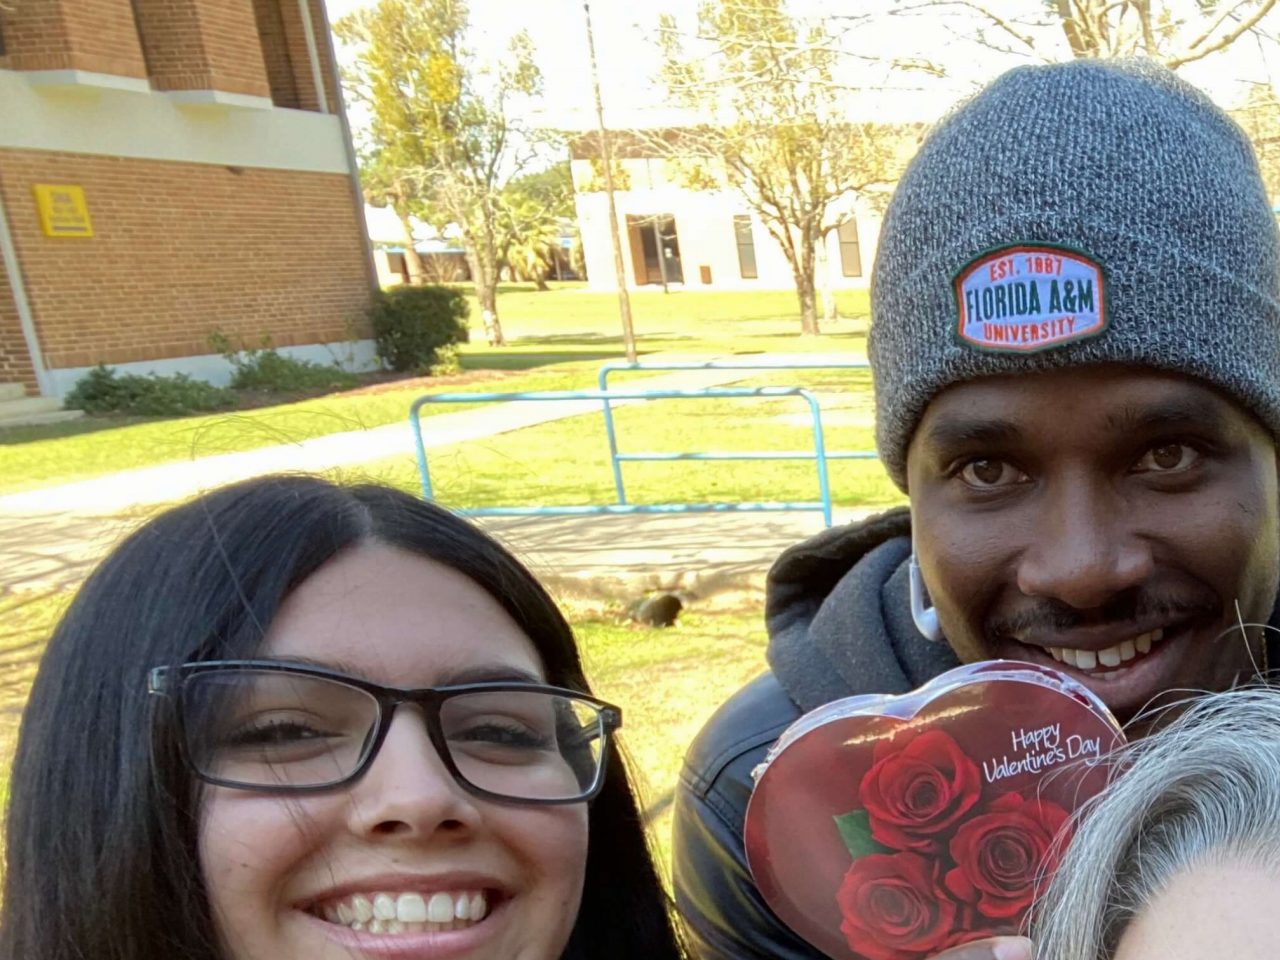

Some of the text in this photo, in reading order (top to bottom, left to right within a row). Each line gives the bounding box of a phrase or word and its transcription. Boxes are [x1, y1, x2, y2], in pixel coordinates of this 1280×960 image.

[989, 256, 1063, 282] EST. 1887
[966, 278, 1094, 324] FLORIDA A&M
[983, 316, 1076, 343] UNIVERSITY
[1011, 723, 1060, 751] Happy
[983, 734, 1100, 783] Valentine's Day
